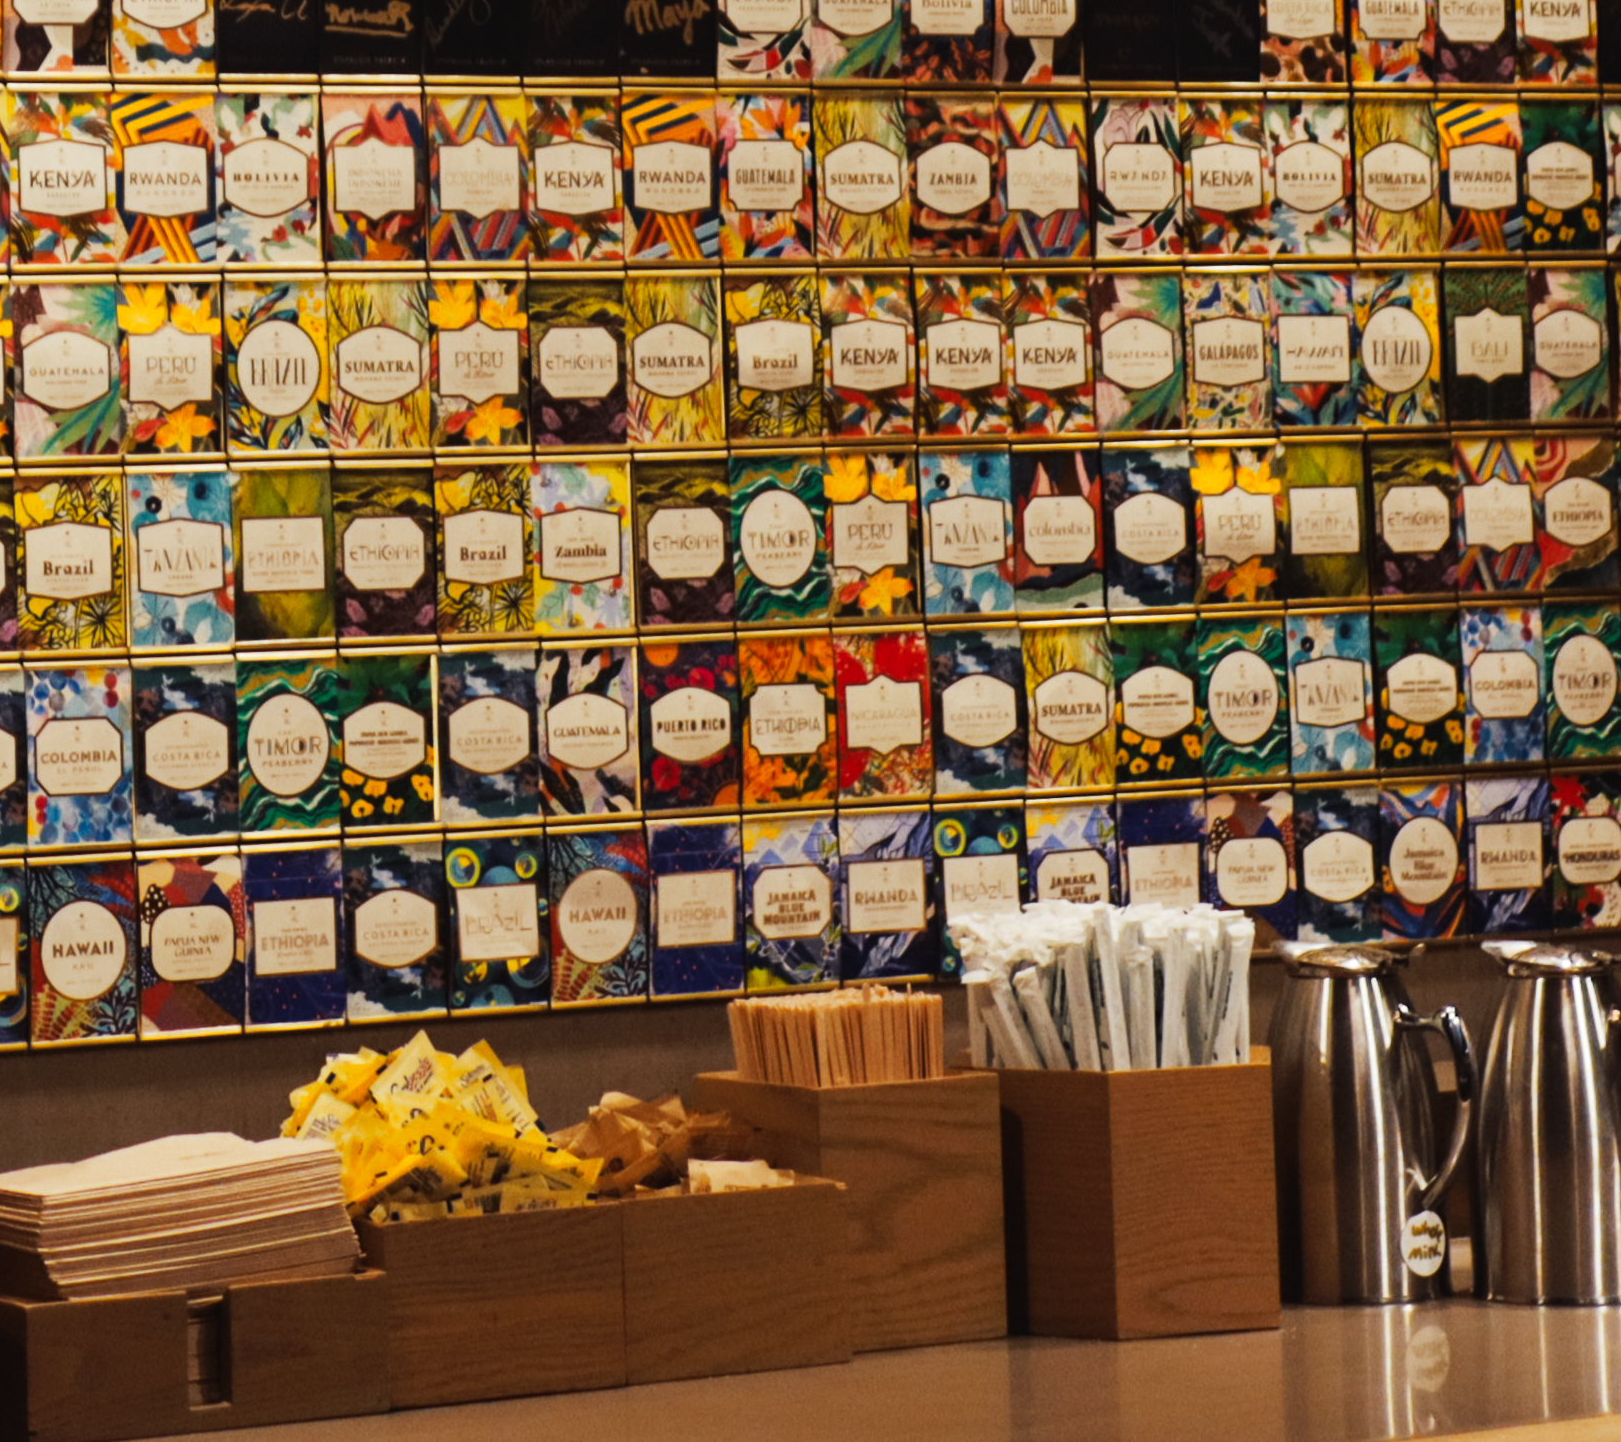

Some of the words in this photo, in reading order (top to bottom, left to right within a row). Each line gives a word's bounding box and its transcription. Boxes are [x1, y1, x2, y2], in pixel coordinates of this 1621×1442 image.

[30, 171, 94, 188] KENYA
[639, 171, 706, 184] RWANDA
[1369, 174, 1426, 185] SUMATRA
[657, 720, 696, 732] PUERTO
[701, 719, 726, 730] RICO
[255, 736, 320, 756] TIMOR
[41, 750, 117, 764] COLOMBIA
[53, 941, 113, 957] HAWAII
